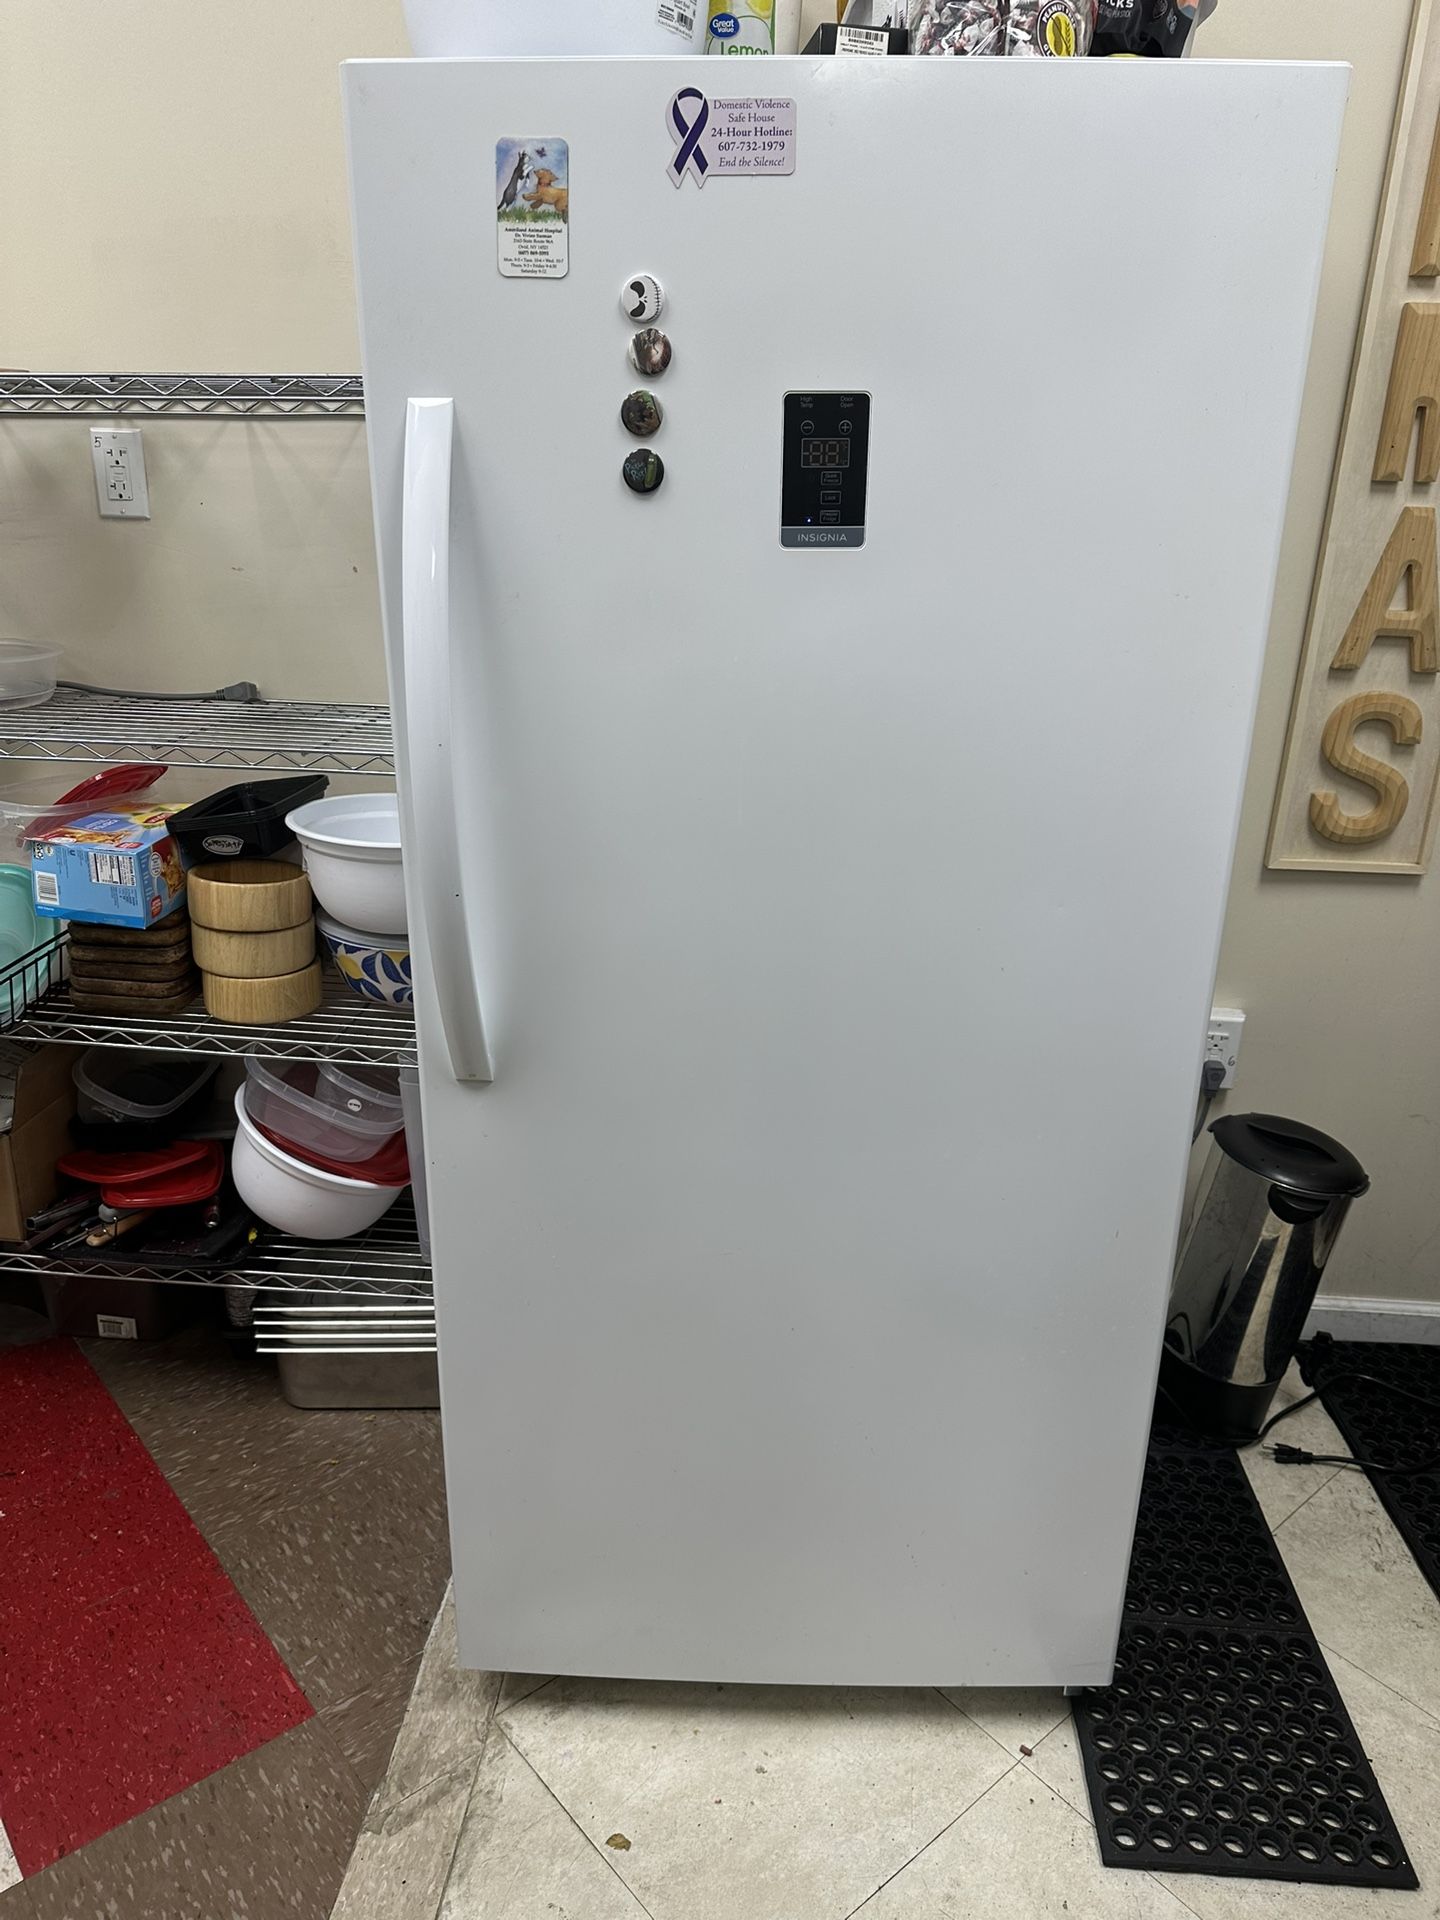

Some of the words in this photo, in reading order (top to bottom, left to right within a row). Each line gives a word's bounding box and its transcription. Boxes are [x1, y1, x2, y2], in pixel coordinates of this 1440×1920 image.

[1041, 4, 1065, 23] PEANUT
[712, 19, 735, 29] Great
[720, 42, 769, 55] Lemon
[713, 99, 753, 110] Domestic
[755, 98, 791, 109] Violence
[728, 112, 746, 123] Safe
[748, 112, 776, 122] House
[711, 126, 753, 137] 24-Hour
[754, 126, 793, 137] Hotline:
[718, 141, 785, 151] 607-732-1979
[719, 156, 737, 167] End
[738, 156, 752, 167] the
[753, 156, 785, 167] Silence!
[797, 533, 847, 542] INSIGNIA
